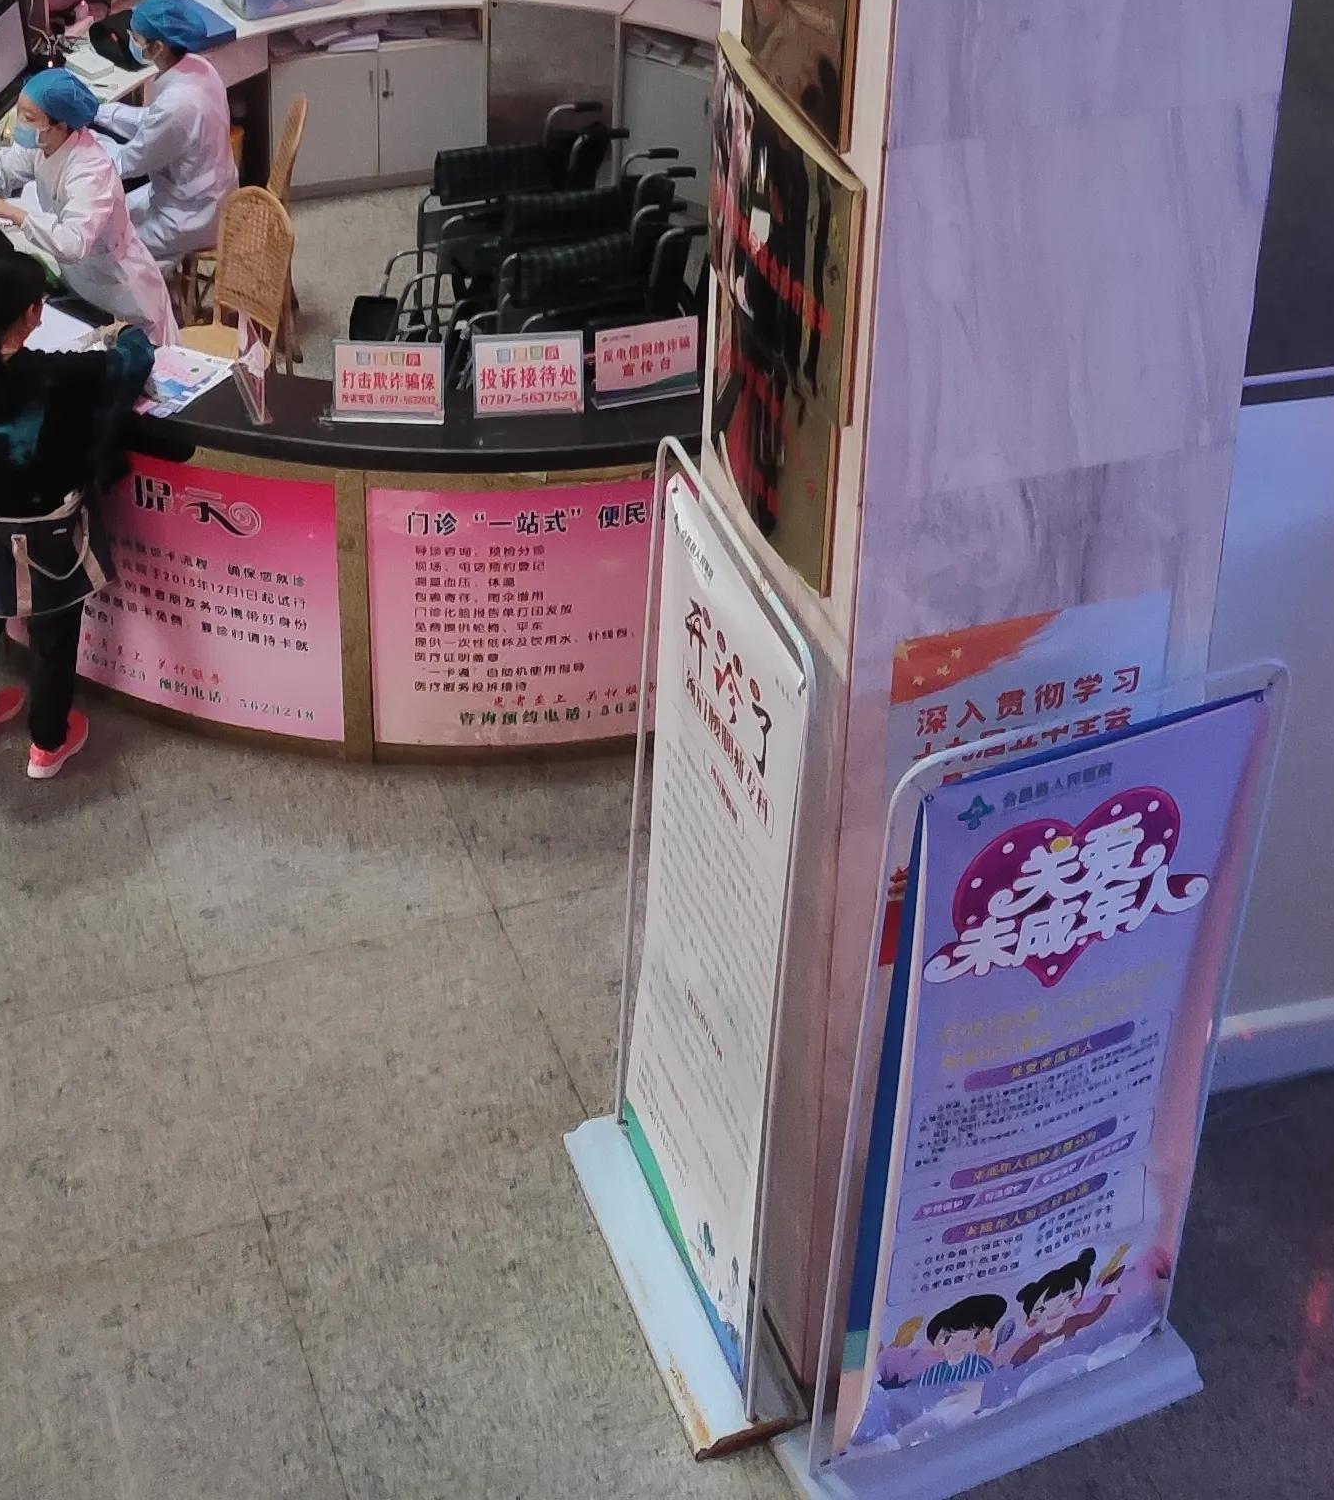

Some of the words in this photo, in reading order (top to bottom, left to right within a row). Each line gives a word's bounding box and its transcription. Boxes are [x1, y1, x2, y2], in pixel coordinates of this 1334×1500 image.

[342, 369, 436, 390] 打击欺诈骗保
[480, 364, 577, 390] 投诉接待处
[916, 666, 1141, 737] 深入贯彻学习
[989, 812, 1167, 919] 关爱
[923, 866, 1210, 984] 未成年人
